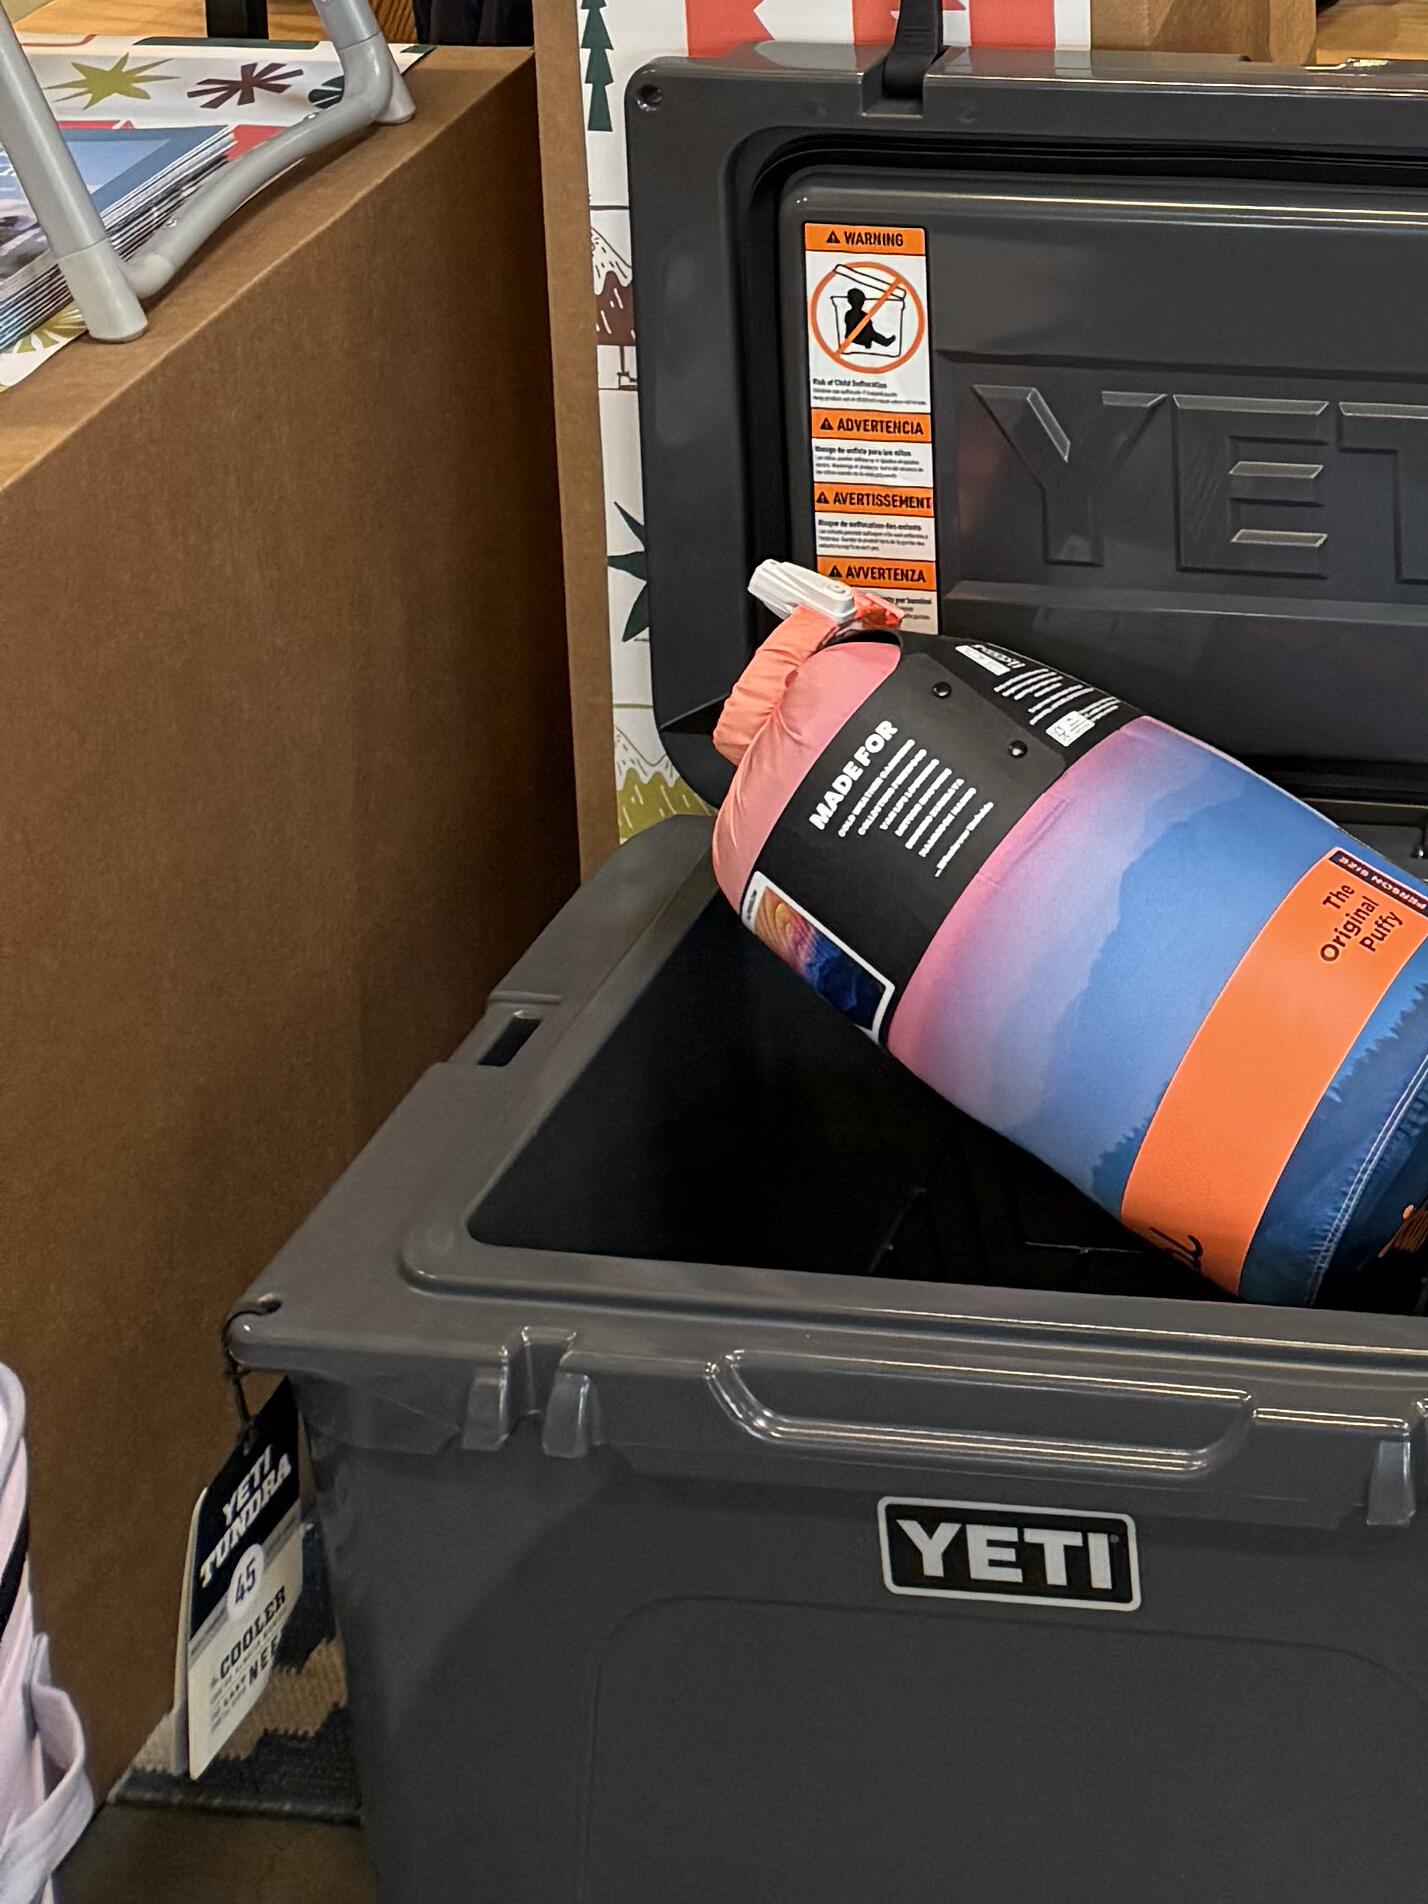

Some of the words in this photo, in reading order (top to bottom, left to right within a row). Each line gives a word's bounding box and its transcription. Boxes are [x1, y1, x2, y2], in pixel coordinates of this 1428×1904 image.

[843, 231, 904, 247] WARNING
[836, 417, 924, 435] ADVERTENCIA
[832, 491, 931, 509] AVERTISSEMENT
[845, 565, 926, 583] AVVERTENZA
[808, 760, 864, 831] MADE
[853, 720, 899, 767] FOR
[1338, 856, 1369, 878] SIZE
[1322, 884, 1356, 910] The
[1371, 875, 1428, 911] PERSON
[1320, 895, 1380, 962] Original
[1359, 911, 1403, 953] Puffy
[222, 1443, 272, 1527] YETI
[199, 1452, 292, 1589] TUNDRA
[895, 1518, 1113, 1590] YETI
[235, 1557, 257, 1604] 45
[219, 1585, 286, 1680] COOLER
